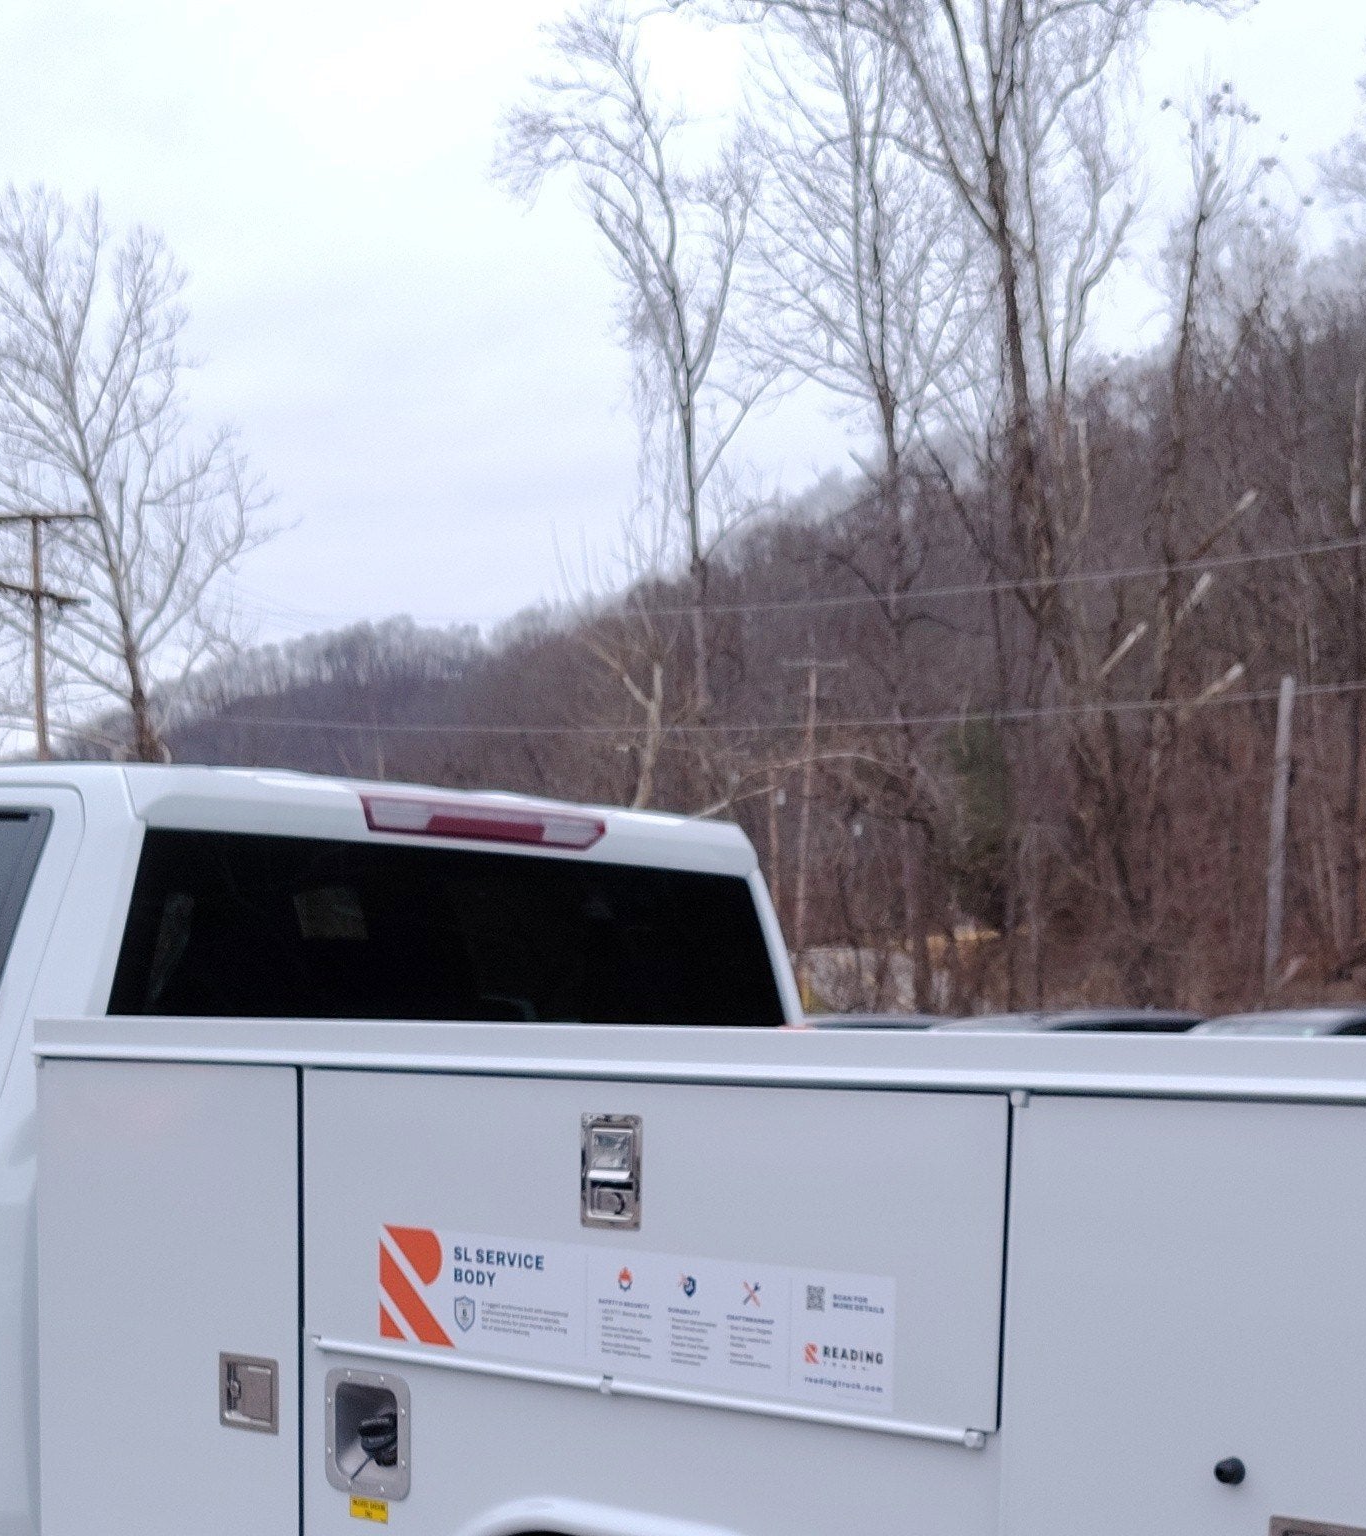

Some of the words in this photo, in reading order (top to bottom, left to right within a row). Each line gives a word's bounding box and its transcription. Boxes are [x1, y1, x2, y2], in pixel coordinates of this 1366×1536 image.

[454, 1246, 472, 1262] SL
[476, 1248, 545, 1271] SERVICE
[454, 1267, 496, 1287] BODY
[823, 1345, 883, 1365] READING
